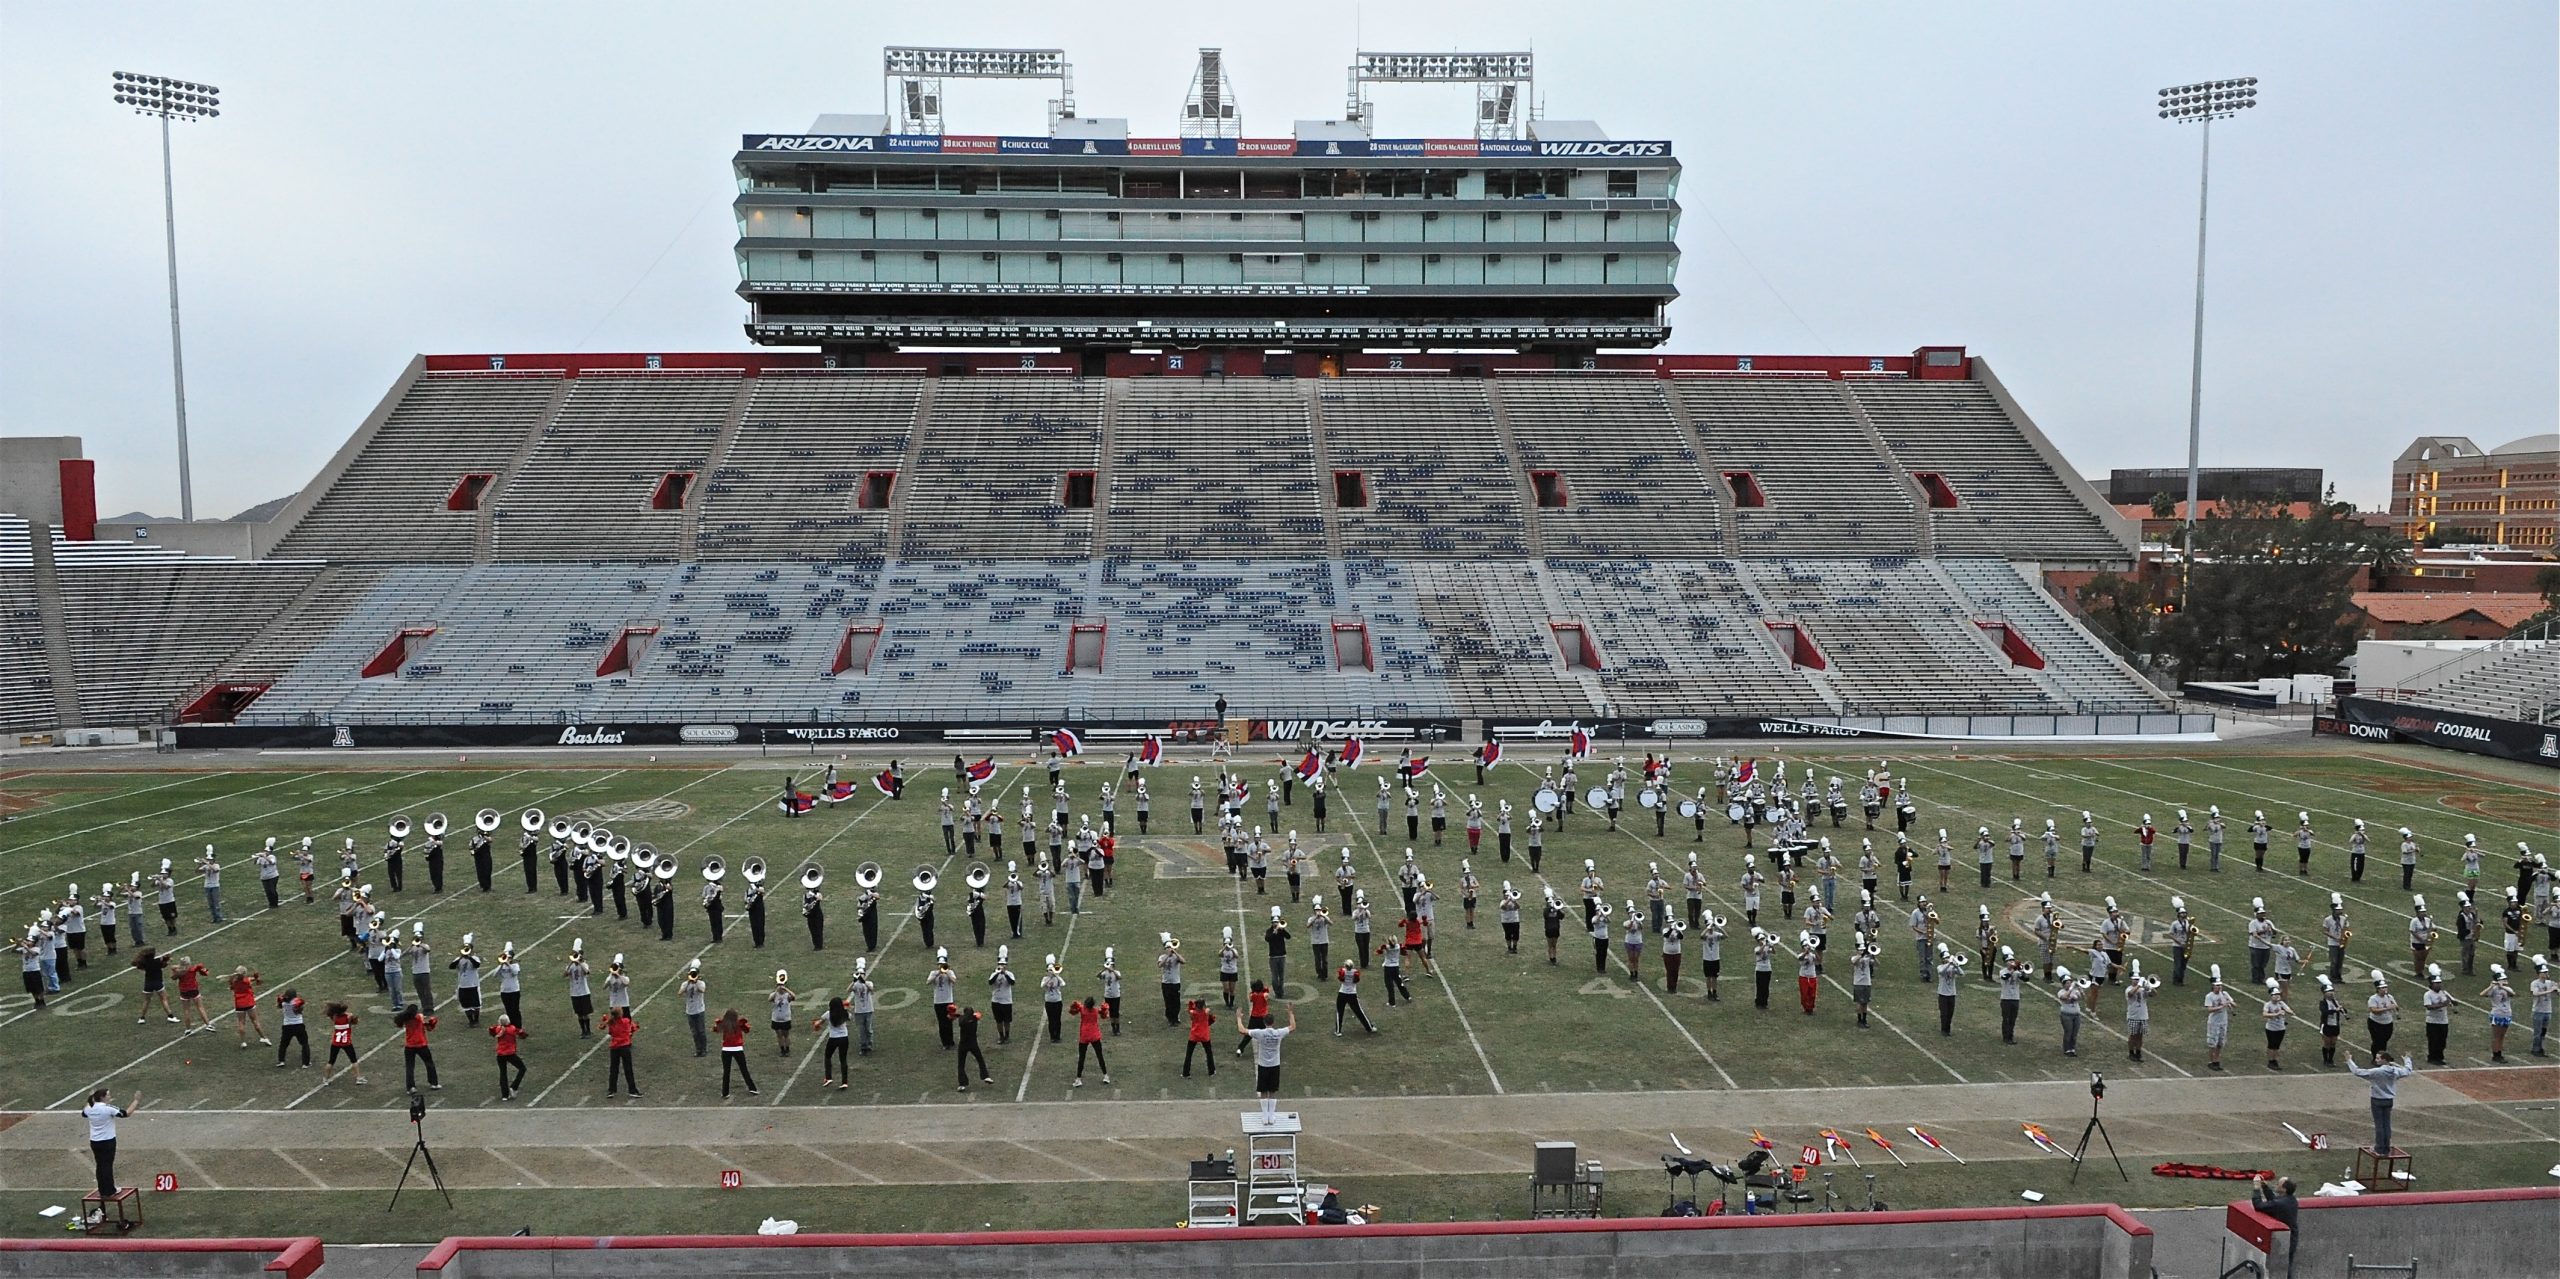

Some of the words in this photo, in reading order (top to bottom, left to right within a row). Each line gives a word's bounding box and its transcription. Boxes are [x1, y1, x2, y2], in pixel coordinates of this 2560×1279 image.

[756, 137, 873, 151] ARIZONA
[889, 138, 897, 147] 22
[898, 139, 910, 147] ART
[911, 139, 939, 148] LUPPINO
[952, 140, 970, 148] RICKY
[972, 140, 997, 149] HUNLEY
[1007, 141, 1030, 149] CHUCK
[1031, 141, 1049, 149] CECIL
[1128, 142, 1133, 151] 4
[1133, 142, 1160, 151] DARRYLL
[1161, 142, 1181, 151] LEWIS
[1246, 143, 1259, 151] ROB
[1260, 143, 1290, 151] WALDROP
[1378, 143, 1391, 151] STEVE
[1431, 143, 1448, 151] CHRIS
[1449, 143, 1479, 152] McALISTER
[1480, 144, 1484, 152] 5
[1484, 144, 1509, 152] ANTOINE
[1510, 144, 1532, 152] CASON
[1540, 143, 1664, 156] WILDCATS
[492, 361, 502, 370] 17
[648, 360, 659, 369] 18
[825, 359, 836, 368] 19
[1022, 359, 1035, 368] 20
[1170, 359, 1182, 369] 21
[1390, 360, 1402, 369] 22
[1583, 360, 1595, 370] 23
[1738, 362, 1751, 371] 24
[1871, 363, 1884, 372] 25
[137, 528, 147, 537] 16
[1759, 722, 1810, 734] WELLS
[2318, 720, 2349, 734] BEAR
[2349, 724, 2389, 740] DOWN
[2434, 722, 2491, 742] FOOTBALL
[558, 726, 625, 745] Bashas'
[793, 728, 846, 739] WELLS
[849, 728, 899, 740] FARGO
[1578, 977, 1708, 998] 40
[2313, 1135, 2328, 1150] 30
[1803, 1147, 1817, 1164] 40
[1264, 1154, 1280, 1169] 50
[157, 1174, 173, 1191] 30
[723, 1171, 739, 1187] 40
